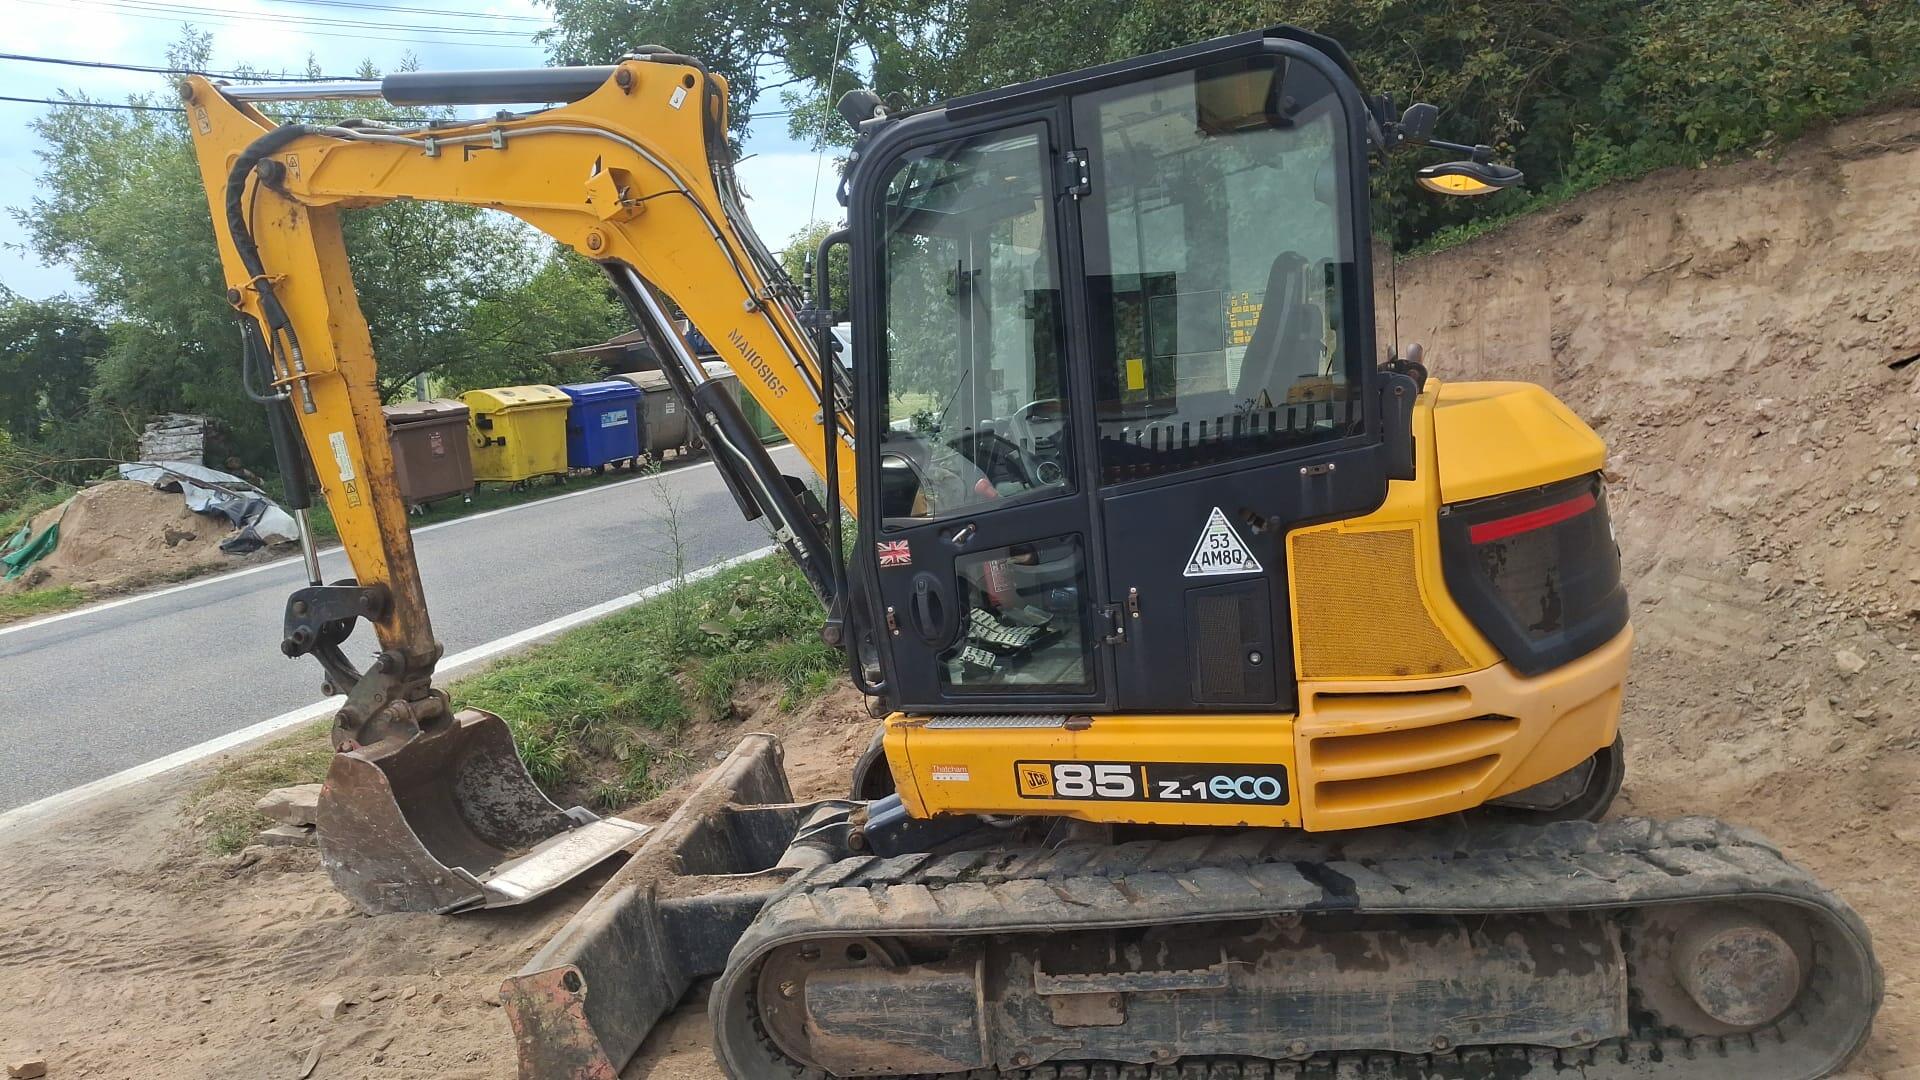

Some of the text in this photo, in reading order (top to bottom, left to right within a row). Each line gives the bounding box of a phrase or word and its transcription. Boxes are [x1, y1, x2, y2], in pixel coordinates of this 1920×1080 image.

[1209, 533, 1230, 549] 53
[1202, 549, 1242, 566] AM8Q
[1027, 771, 1049, 787] JCB
[1053, 764, 1135, 798] 85
